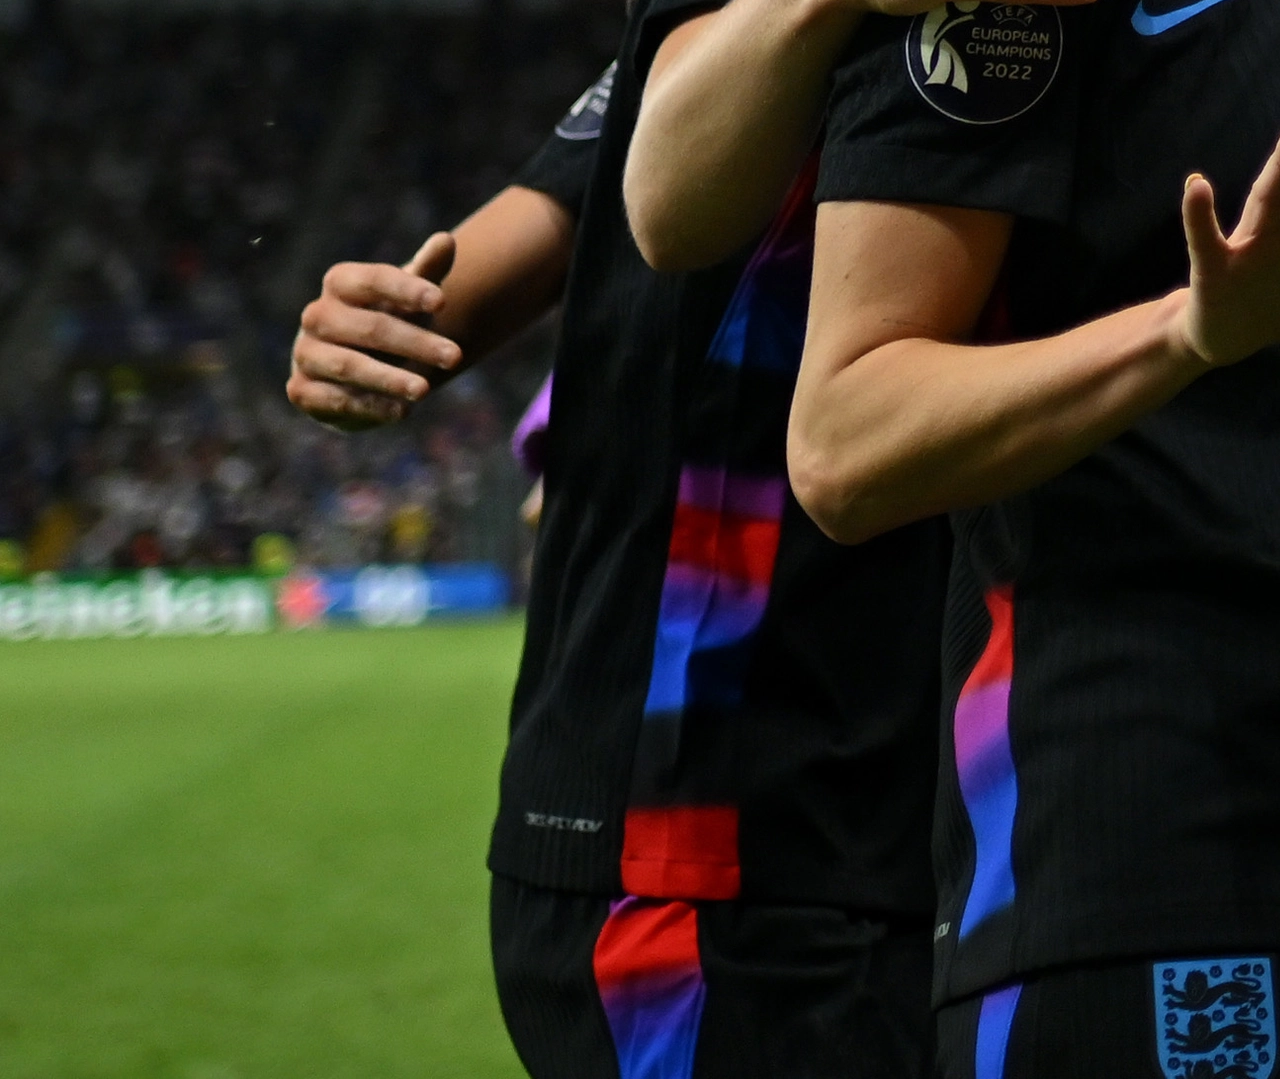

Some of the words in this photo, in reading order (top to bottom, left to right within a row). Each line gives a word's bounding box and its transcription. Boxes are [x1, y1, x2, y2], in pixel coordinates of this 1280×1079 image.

[992, 6, 1034, 24] UEFA
[971, 27, 1049, 44] EUROPEAN
[966, 43, 1051, 60] CHAMPIONS
[982, 62, 1032, 80] 2022
